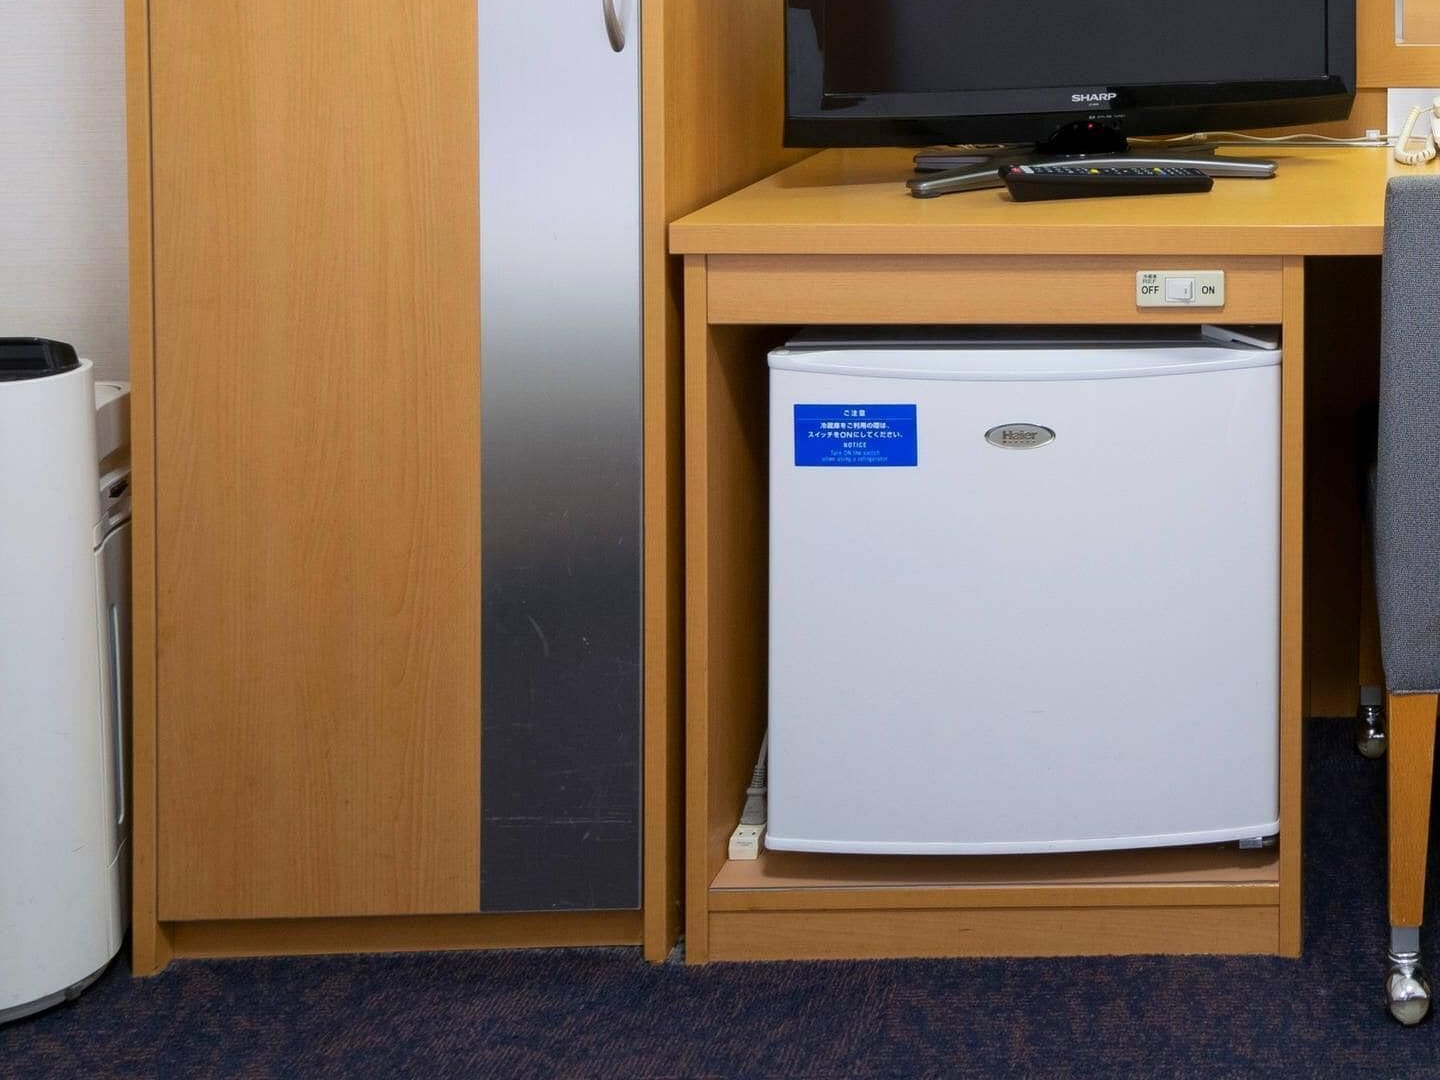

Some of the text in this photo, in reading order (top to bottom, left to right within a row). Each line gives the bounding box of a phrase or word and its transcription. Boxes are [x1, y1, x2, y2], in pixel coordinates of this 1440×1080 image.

[1071, 92, 1117, 102] SHARP
[1141, 286, 1159, 295] OFF
[1201, 286, 1215, 294] ON
[1002, 430, 1038, 440] Haier
